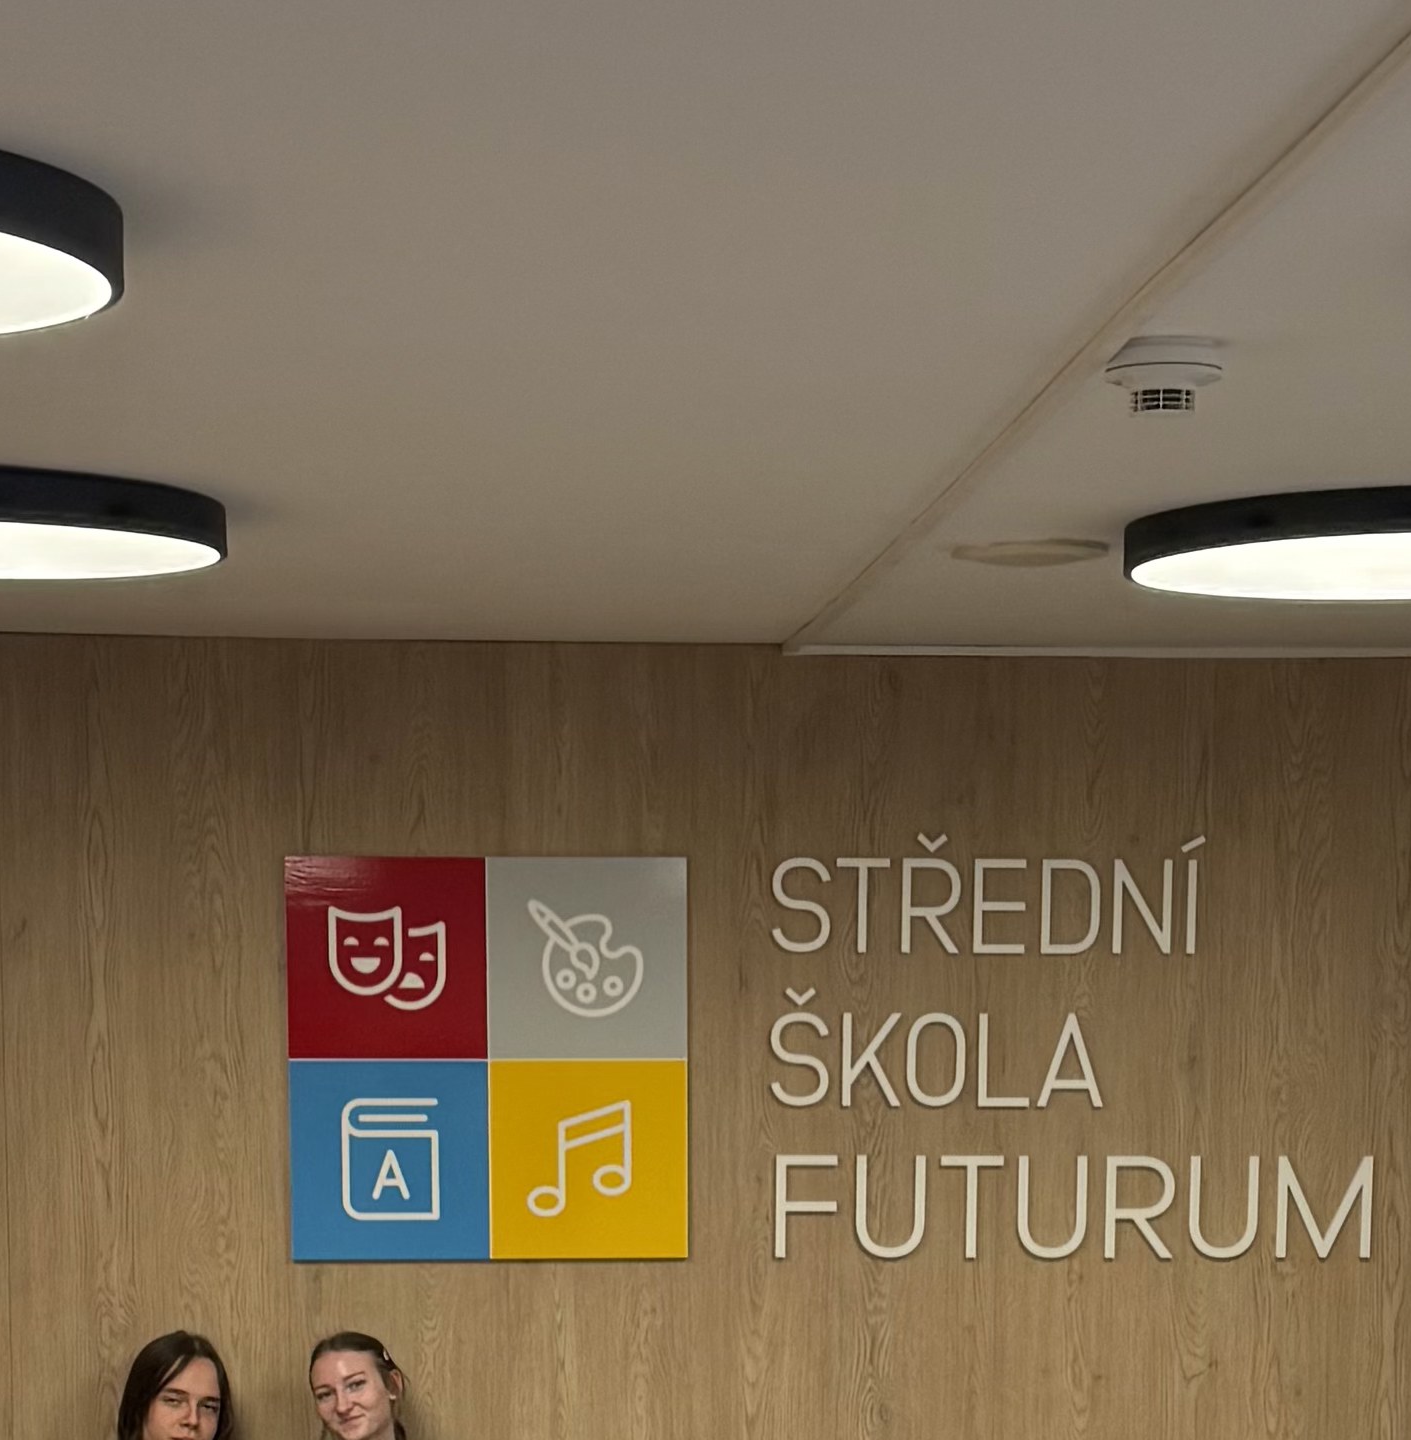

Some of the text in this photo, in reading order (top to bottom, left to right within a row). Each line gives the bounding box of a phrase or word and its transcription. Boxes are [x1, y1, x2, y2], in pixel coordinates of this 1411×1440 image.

[769, 833, 1206, 956] STŘEDNÍ
[769, 986, 1104, 1109] ŠKOLA
[371, 1149, 411, 1201] A
[772, 1153, 1376, 1260] FUTURUM
